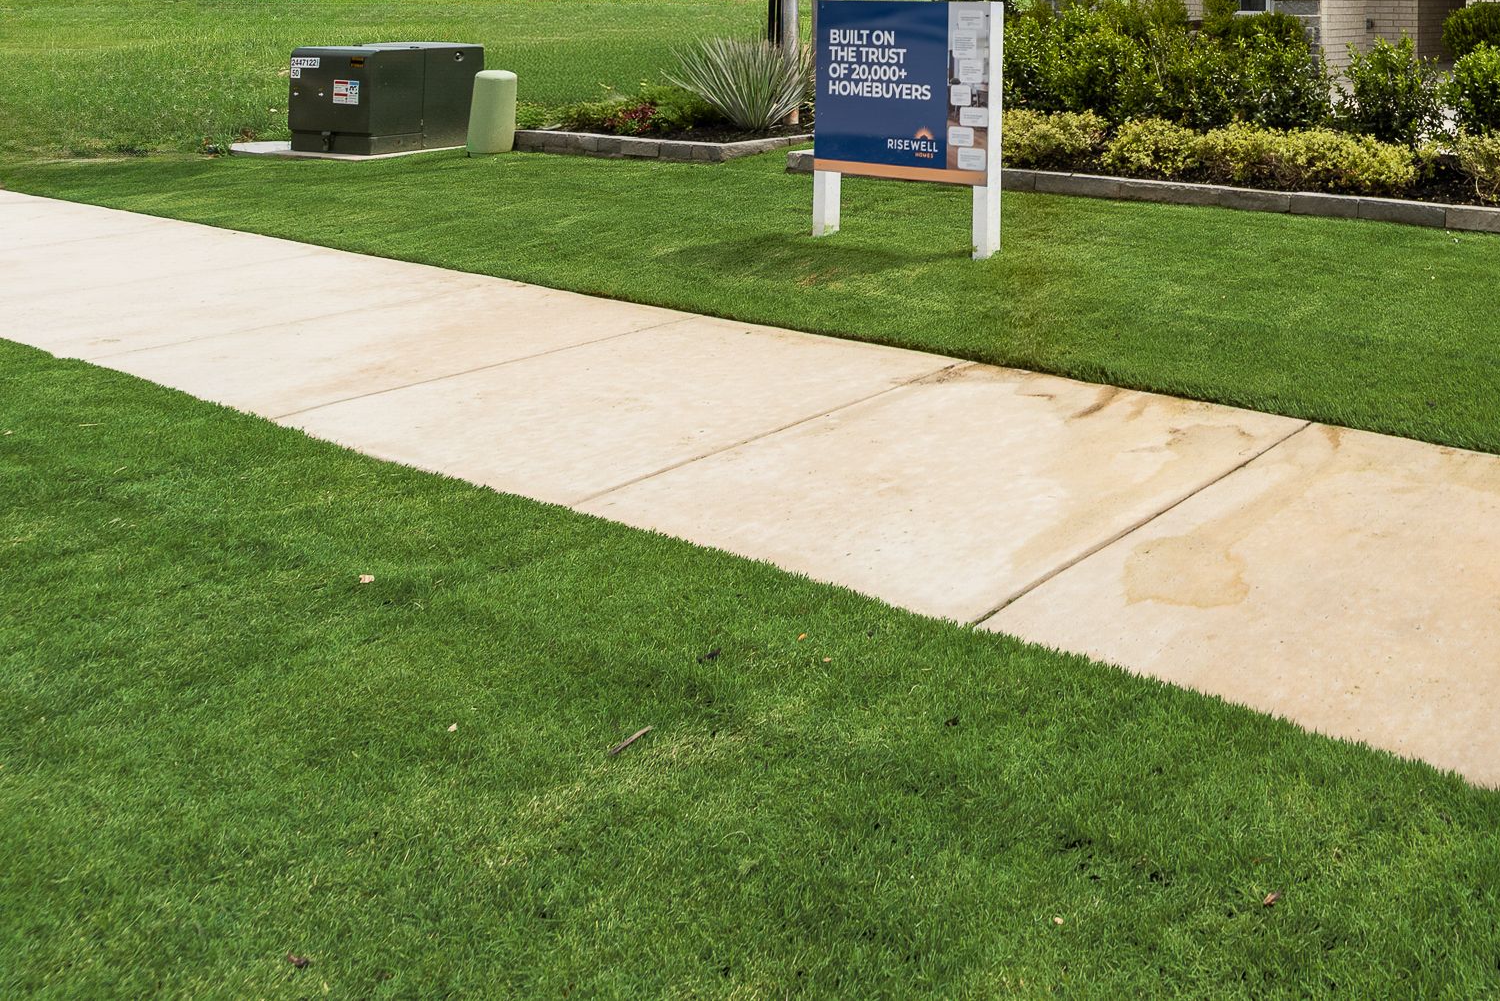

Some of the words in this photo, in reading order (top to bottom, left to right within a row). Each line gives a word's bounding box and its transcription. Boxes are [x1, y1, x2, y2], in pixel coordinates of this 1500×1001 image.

[829, 29, 869, 46] BUILT
[872, 30, 895, 46] ON
[829, 46, 858, 63] THE
[861, 48, 907, 64] TRUST
[829, 63, 848, 79] OF
[851, 64, 907, 82] 20,000+
[828, 81, 931, 101] HOMEBUYERS
[887, 138, 938, 152] RISEWELL
